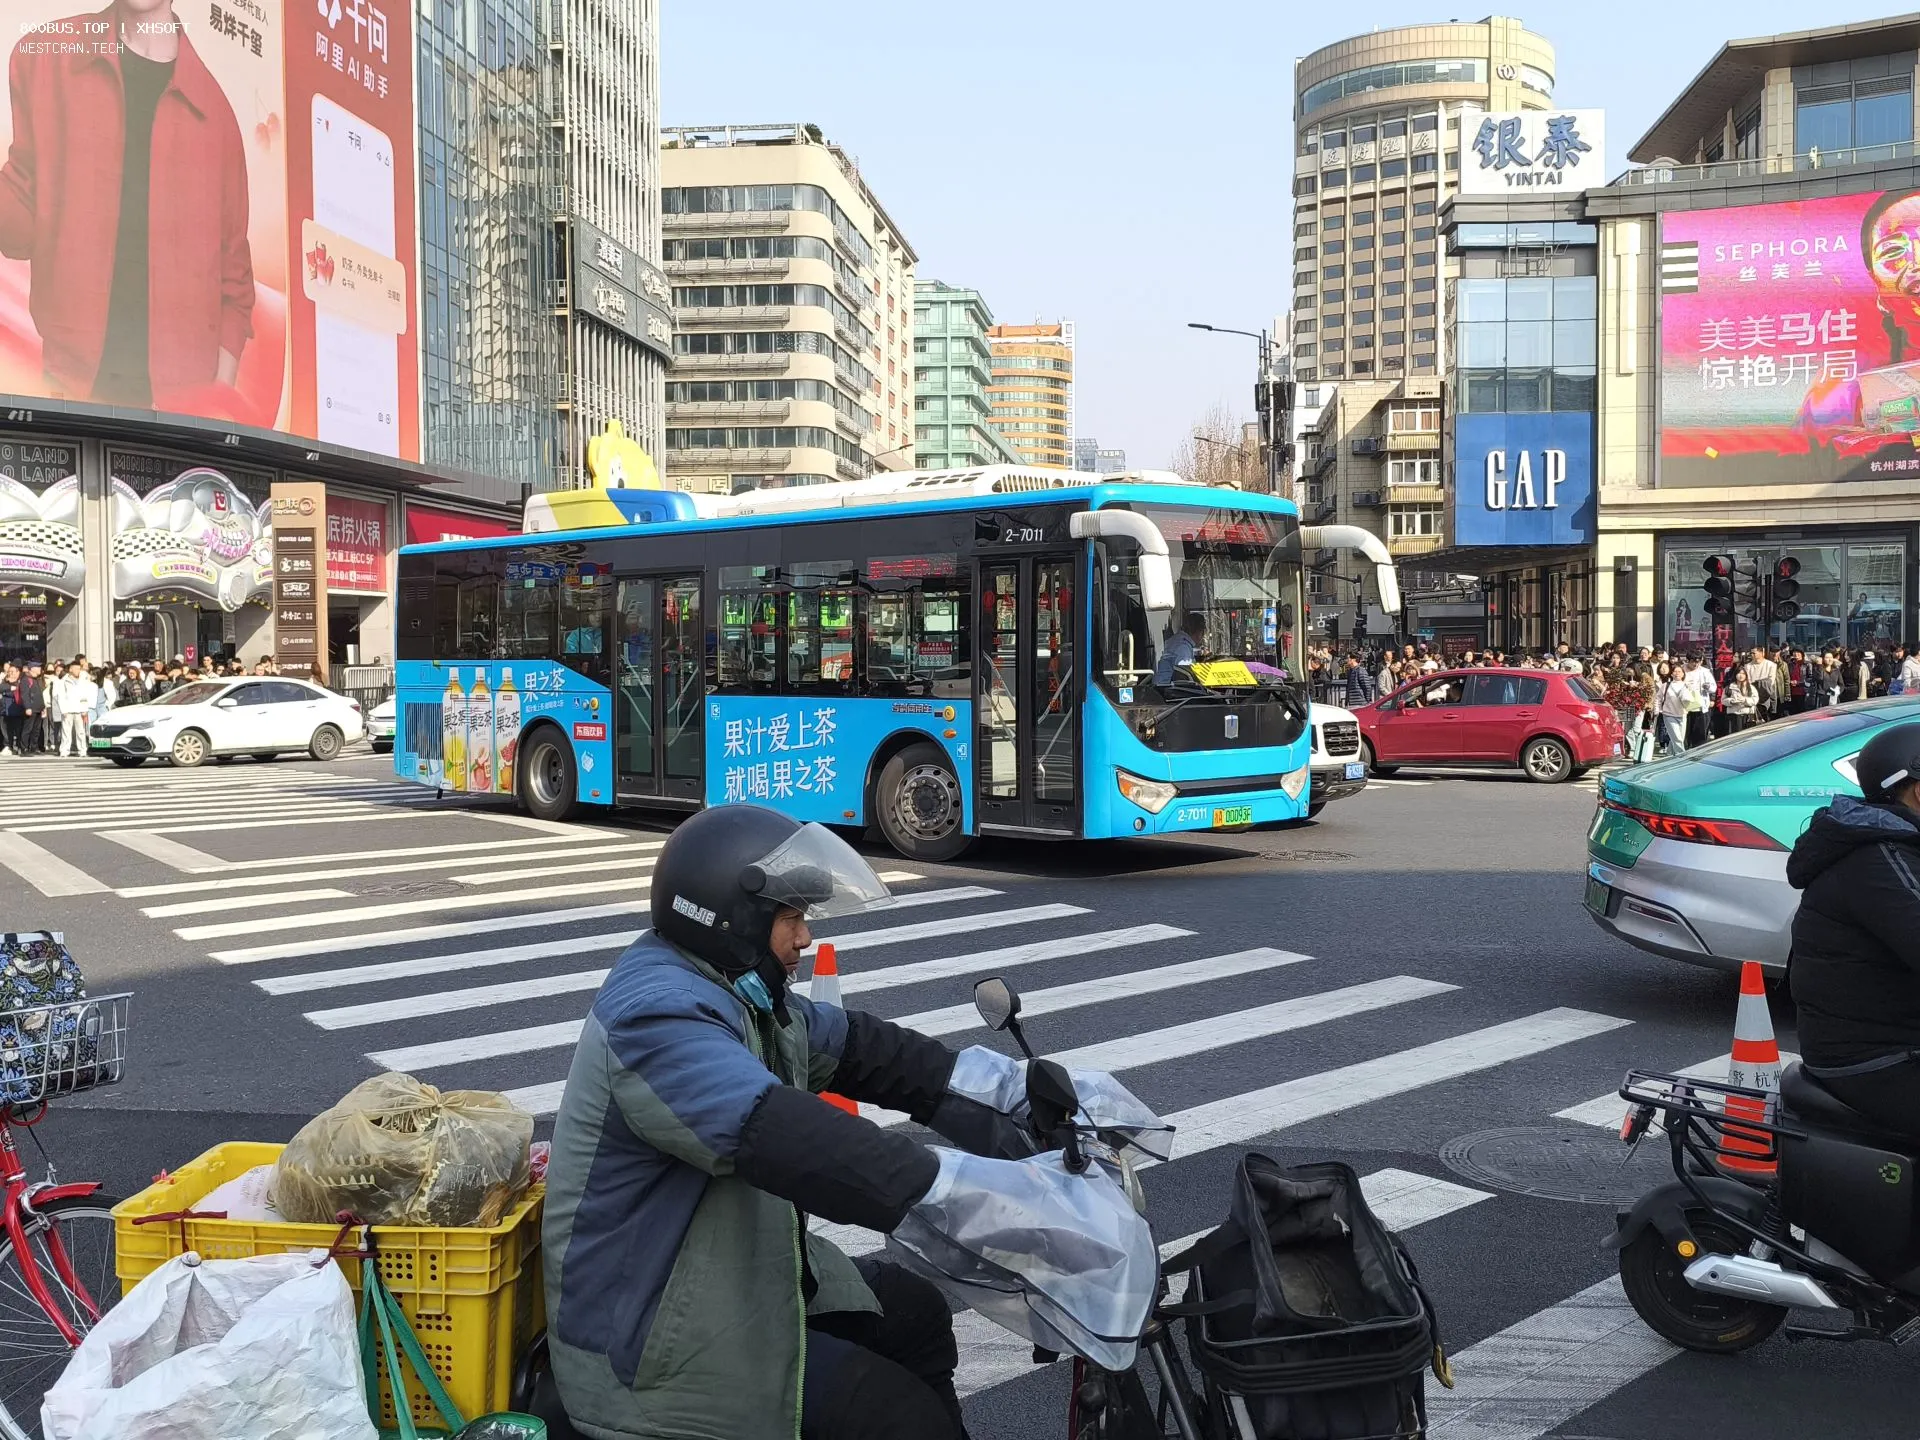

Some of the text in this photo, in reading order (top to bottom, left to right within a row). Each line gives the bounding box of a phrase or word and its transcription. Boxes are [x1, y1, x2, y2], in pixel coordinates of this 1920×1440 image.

[209, 3, 263, 58] 易烊千玺
[345, 0, 388, 64] 千问
[1472, 115, 1593, 171] 银泰
[1505, 171, 1563, 186] YINTAI
[1714, 235, 1849, 262] SEPHORA
[1738, 261, 1823, 282] 丝芙兰
[1699, 308, 1858, 352] 美美马住
[1698, 350, 1857, 390] 惊艳开局
[21, 447, 69, 464] LAND
[113, 454, 162, 473] MINISO
[1486, 449, 1566, 509] GAP
[327, 514, 380, 547] 底捞火锅
[1005, 528, 1043, 542] 2-7011
[523, 668, 566, 703] 果之茶
[444, 709, 467, 732] 果之茶
[469, 709, 493, 732] 果之茶
[496, 710, 520, 735] 果之茶
[723, 706, 838, 759] 果汁爱上茶
[723, 755, 838, 804] 就喝果之茶
[1178, 807, 1208, 822] 2-7011
